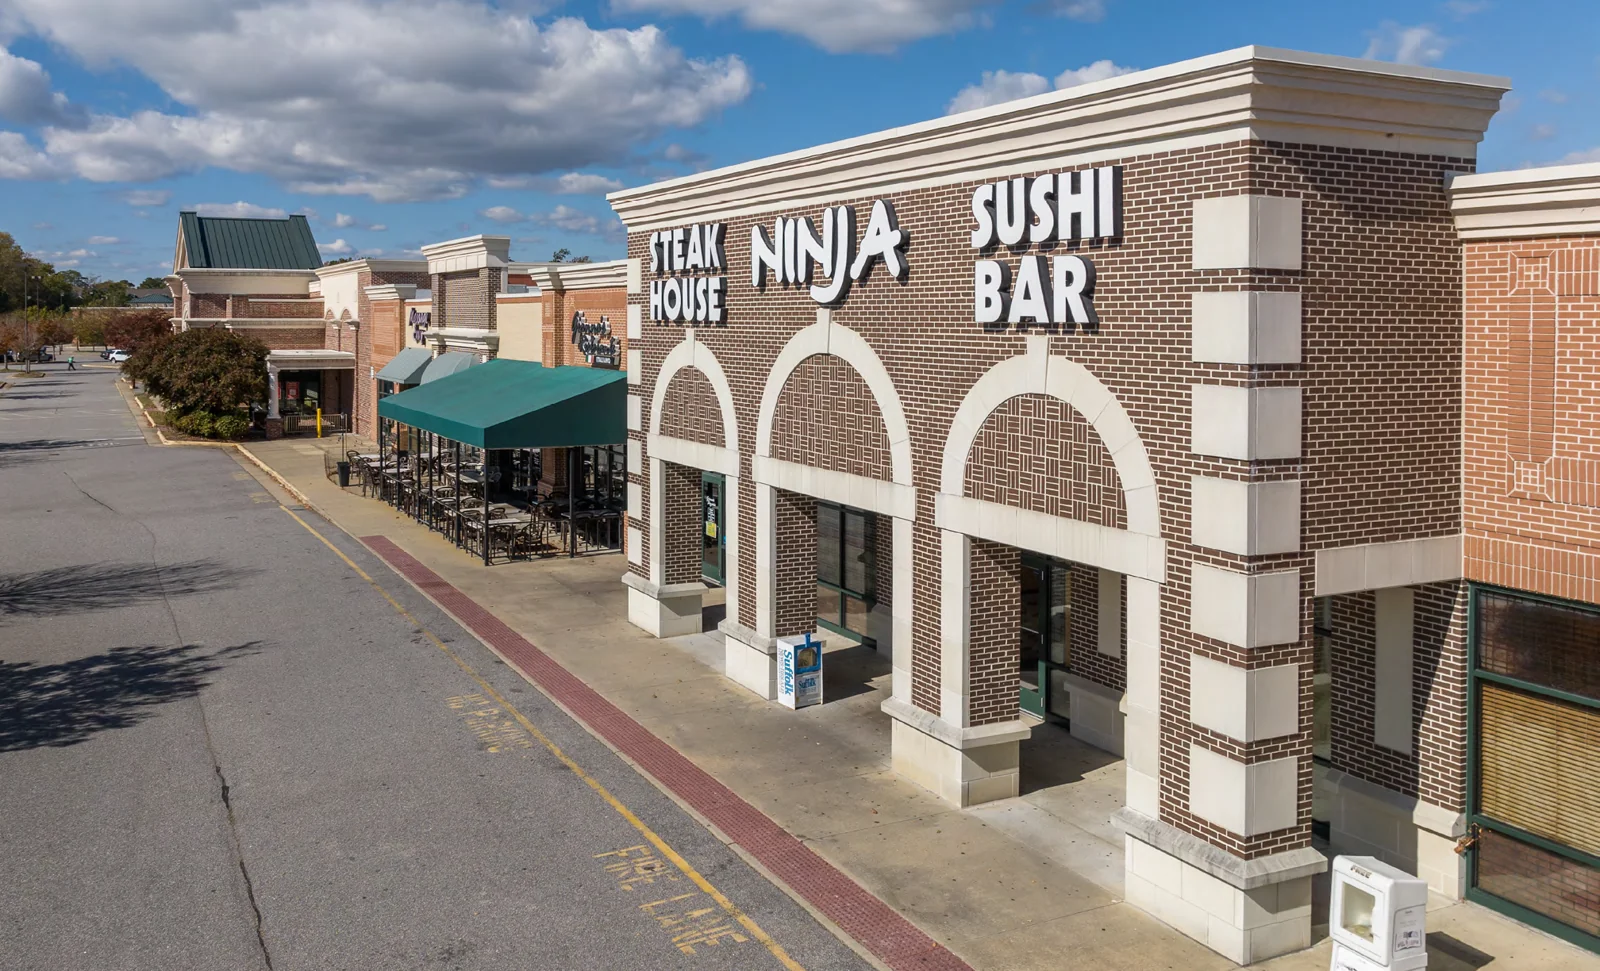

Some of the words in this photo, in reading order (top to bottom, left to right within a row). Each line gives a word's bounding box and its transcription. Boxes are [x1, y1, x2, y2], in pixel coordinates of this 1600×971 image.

[971, 166, 1114, 248] SUSHI
[649, 223, 721, 272] STEAK
[752, 199, 901, 303] NINJA
[649, 277, 721, 321] HOUSE
[975, 255, 1090, 323] BAR
[783, 649, 794, 696] Suffolk
[591, 843, 680, 892] FIRE
[637, 892, 749, 956] LANE
[1350, 864, 1373, 879] FREE
